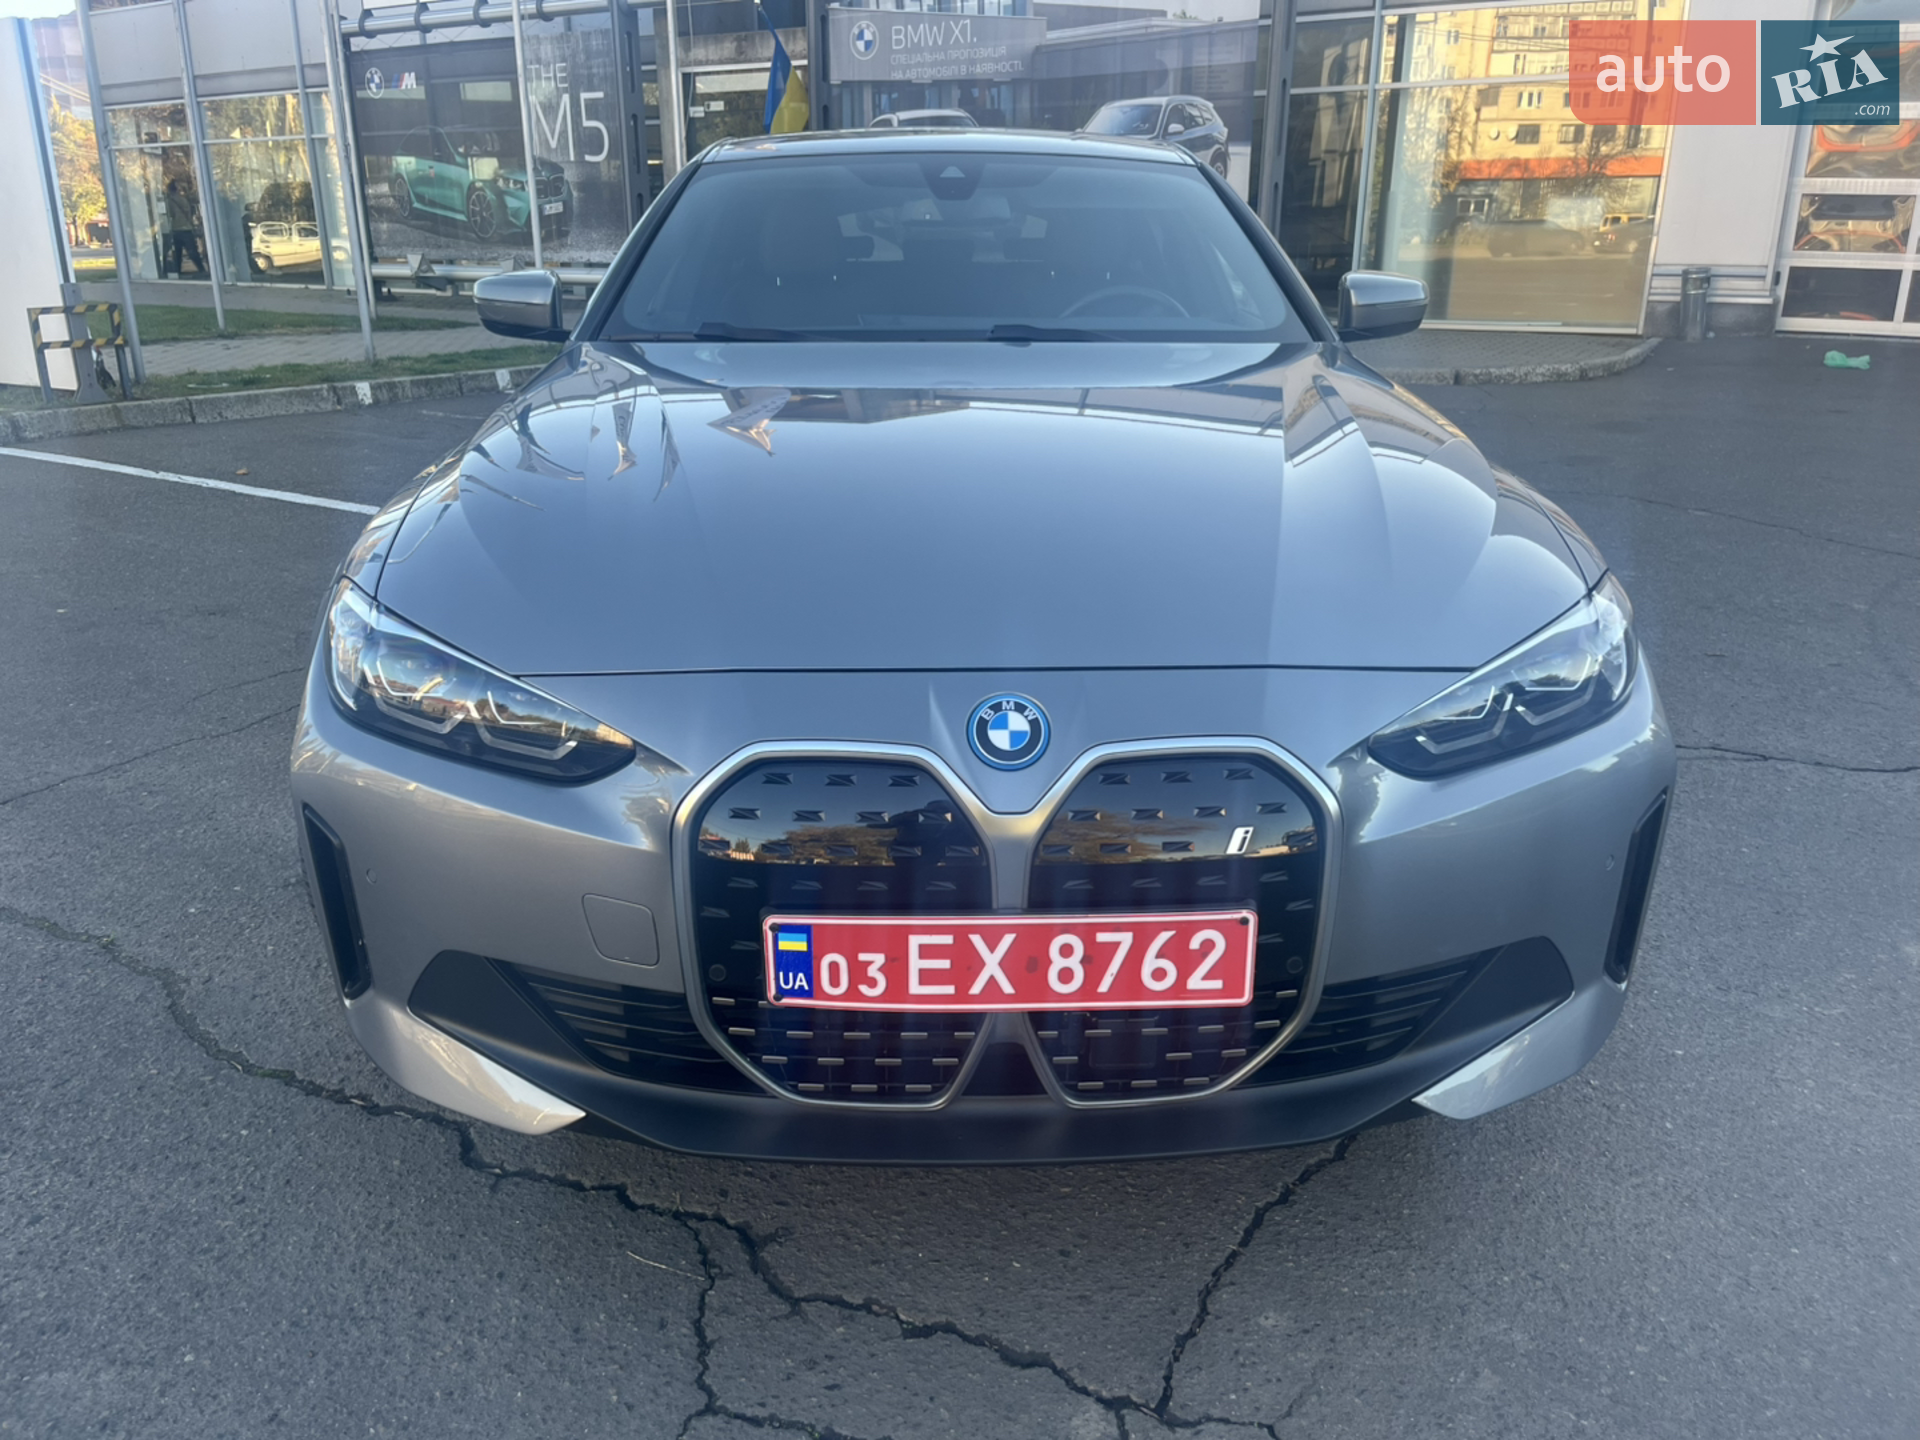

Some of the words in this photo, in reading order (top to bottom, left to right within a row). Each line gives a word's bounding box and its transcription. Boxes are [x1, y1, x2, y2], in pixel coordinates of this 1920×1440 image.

[891, 22, 945, 49] BMW
[950, 19, 977, 46] X1.
[890, 51, 946, 66] СПЕЦІАЛЬНА
[947, 46, 1007, 62] ПРОПОЗИЦІЯ
[527, 62, 569, 88] THE
[891, 68, 904, 80] НА
[905, 66, 958, 79] АВТОМОБІЛІ
[960, 63, 967, 75] В
[530, 91, 610, 163] M5
[980, 700, 1037, 720] BMW
[818, 952, 887, 997] 03
[907, 933, 1017, 996] EX
[1046, 929, 1227, 994] 8762
[778, 971, 809, 991] UA
